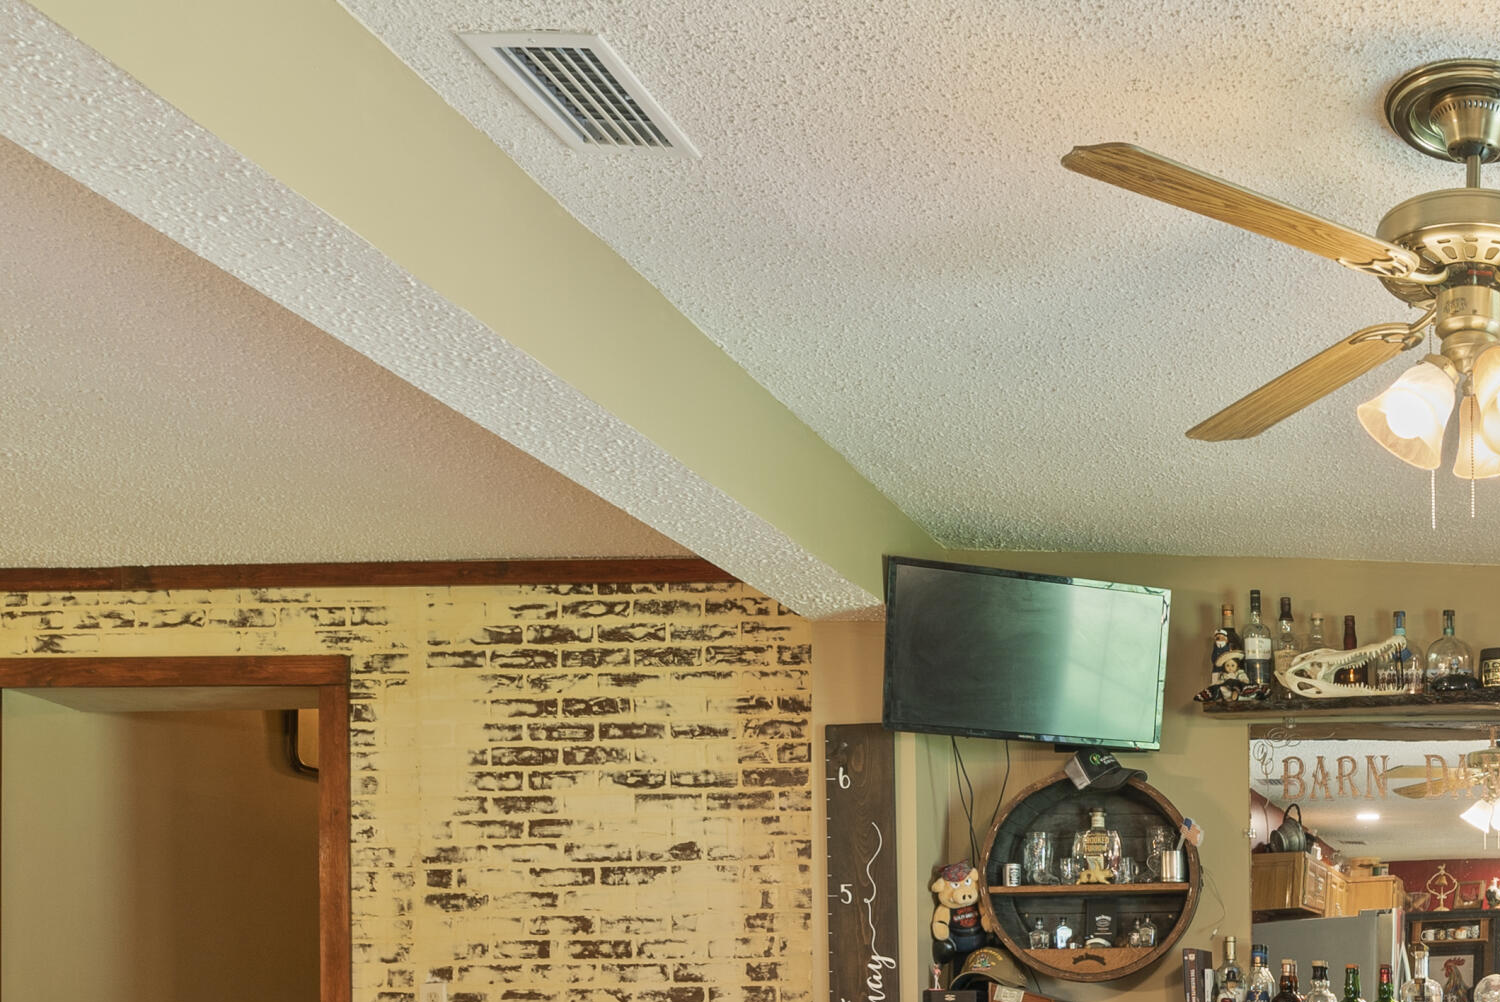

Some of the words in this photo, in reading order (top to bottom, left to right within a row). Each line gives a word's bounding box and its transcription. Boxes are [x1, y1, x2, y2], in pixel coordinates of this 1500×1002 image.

[838, 766, 851, 790] 6
[1282, 755, 1391, 800] BARN
[840, 884, 853, 905] 5
